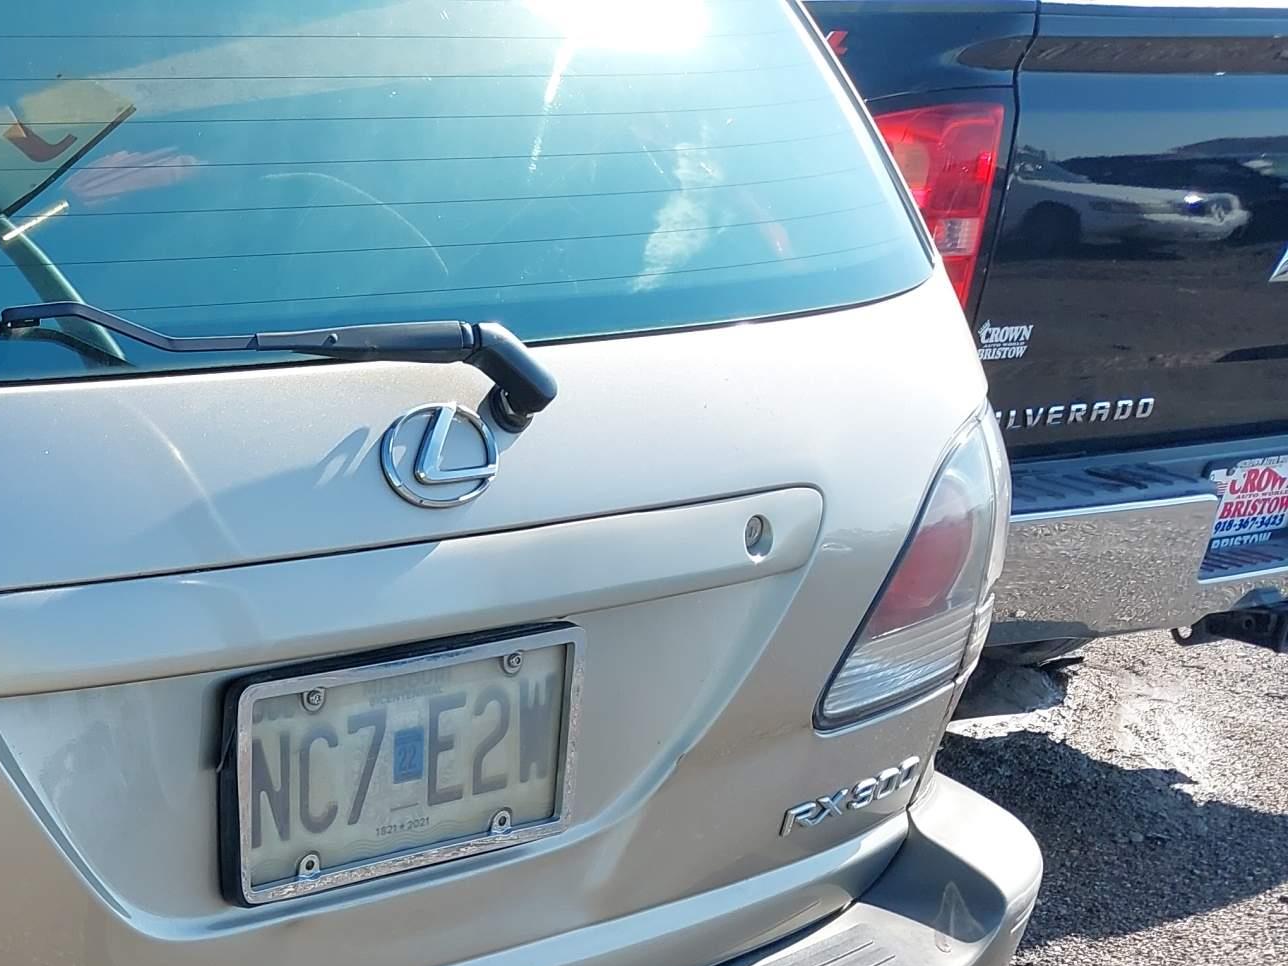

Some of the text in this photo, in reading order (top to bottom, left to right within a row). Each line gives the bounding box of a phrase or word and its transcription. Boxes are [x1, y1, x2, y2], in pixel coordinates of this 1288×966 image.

[980, 324, 1034, 344] CROWN
[977, 345, 1028, 361] BRISTOW
[995, 397, 1155, 430] ILVERADO
[1229, 466, 1288, 495] CROW
[251, 707, 387, 848] NC7
[778, 788, 849, 838] RX
